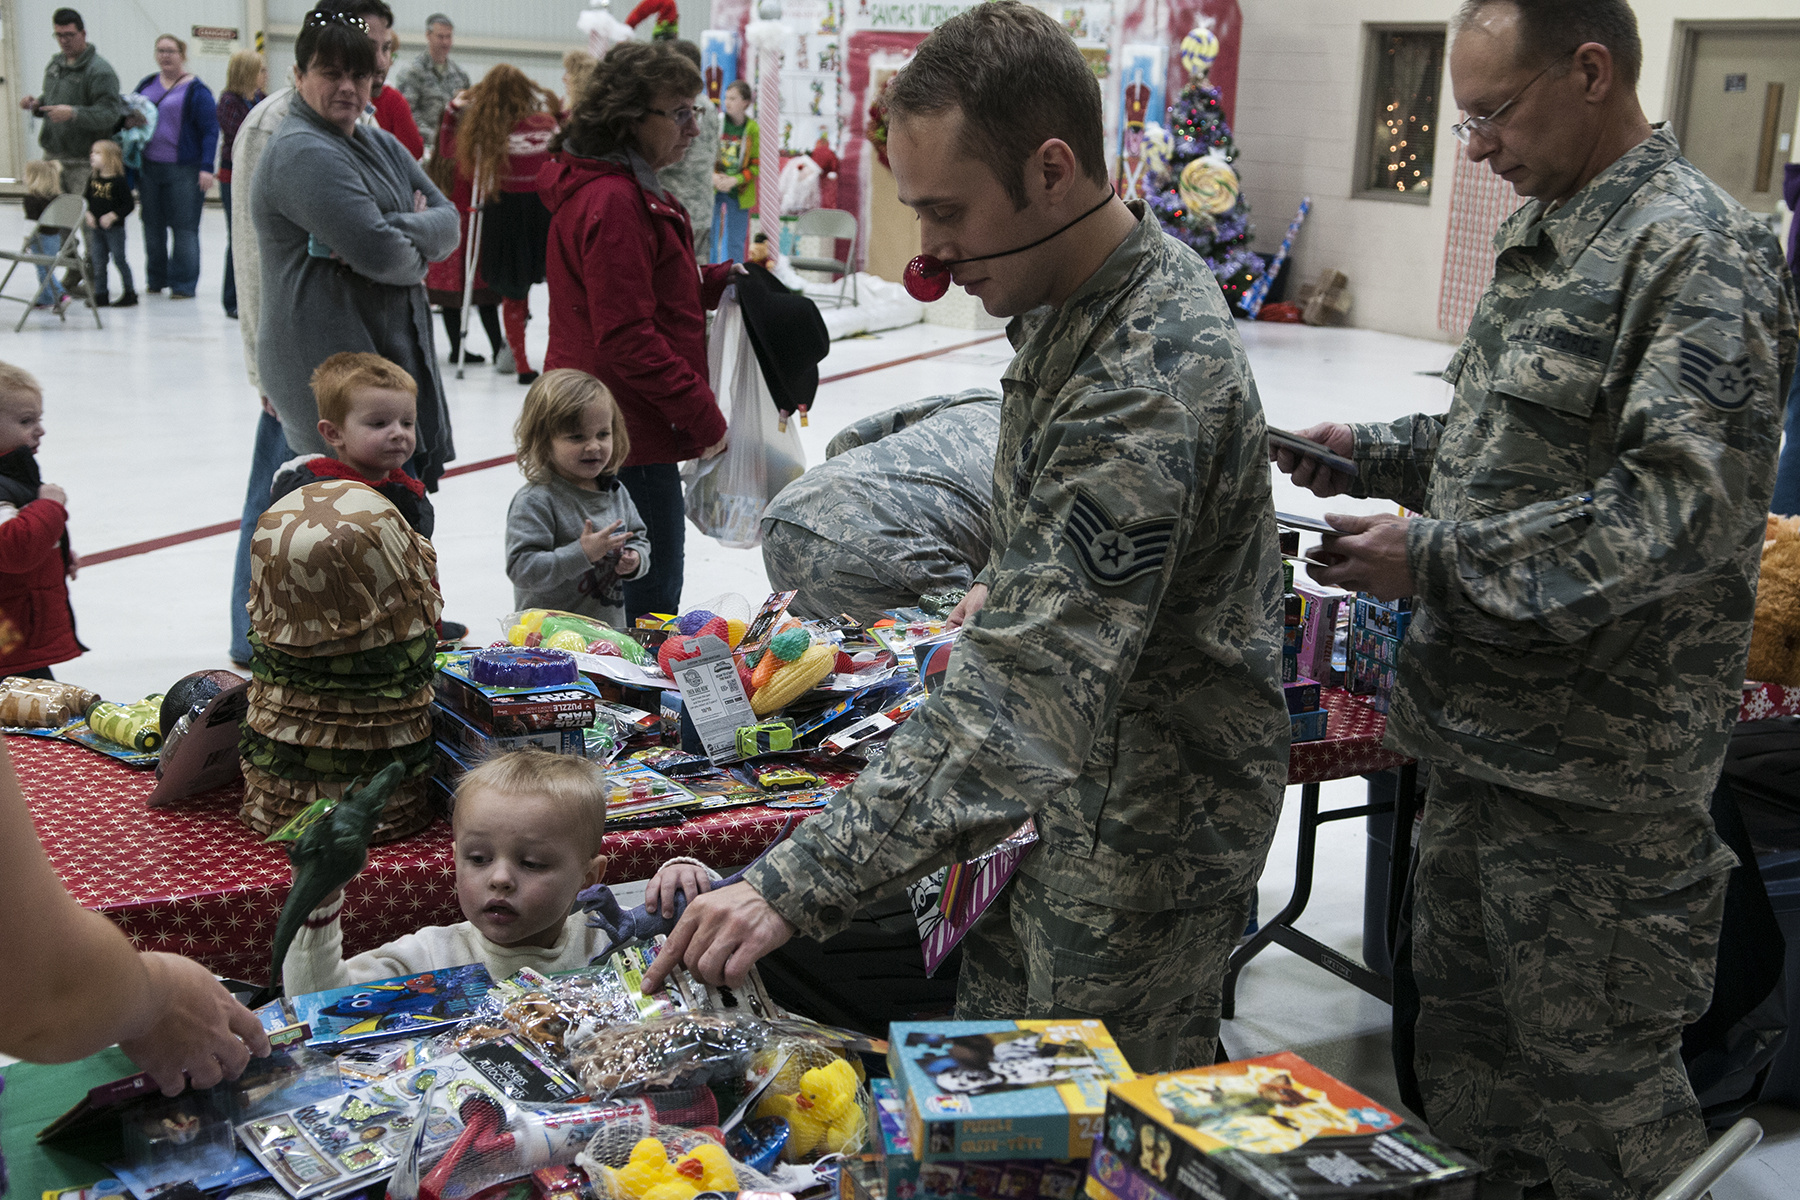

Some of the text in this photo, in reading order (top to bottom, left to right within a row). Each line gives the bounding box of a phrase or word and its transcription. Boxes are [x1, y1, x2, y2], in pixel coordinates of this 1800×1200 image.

[1323, 635, 1334, 662] PUZZLE
[553, 703, 582, 712] PUZZLE
[556, 710, 592, 721] WARS
[554, 718, 588, 727] STAR
[499, 1060, 530, 1087] Stickers
[543, 1081, 557, 1092] 10
[961, 1119, 1013, 1133] PUZZLE
